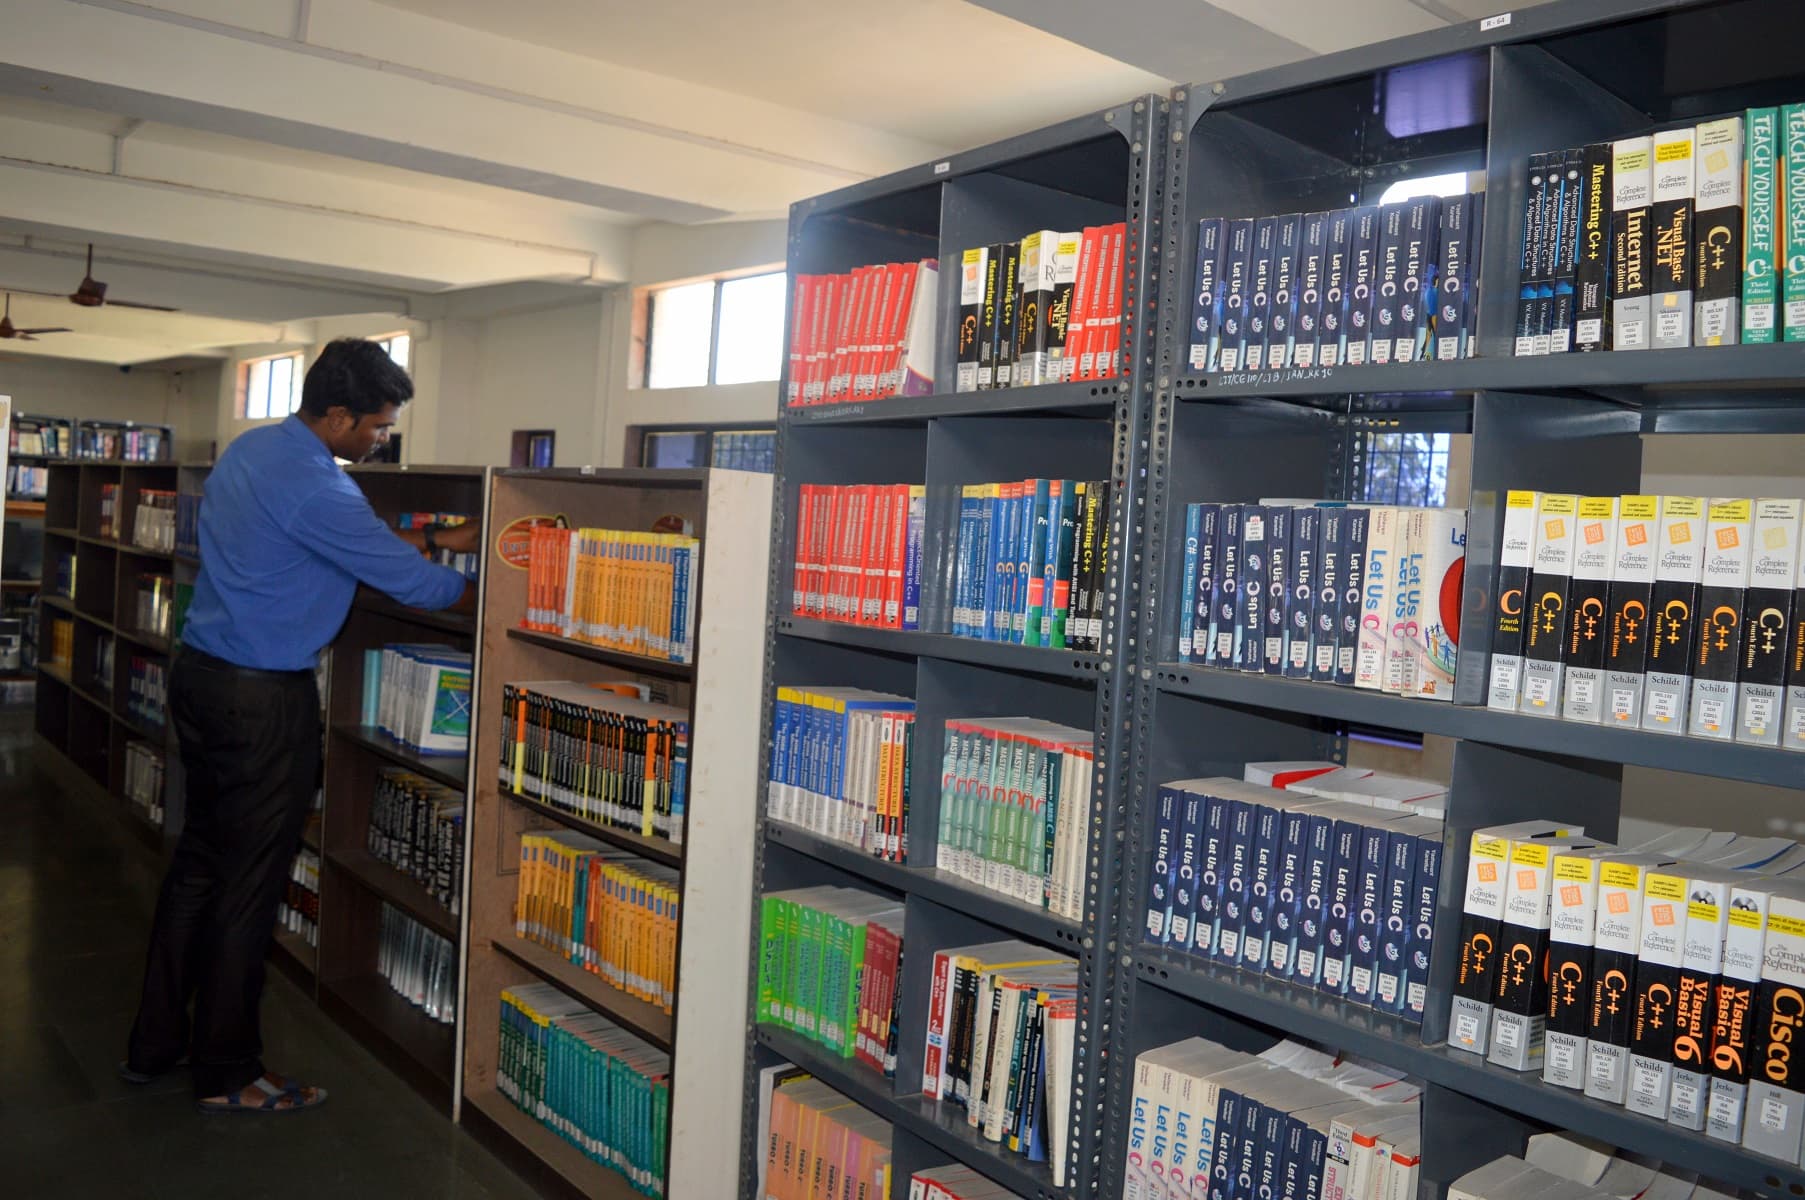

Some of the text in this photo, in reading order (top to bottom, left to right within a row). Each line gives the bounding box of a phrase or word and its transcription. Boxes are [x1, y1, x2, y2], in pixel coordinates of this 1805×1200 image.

[1753, 115, 1770, 251] TEACH YOURSELF
[1791, 112, 1805, 245] TEACH YOURSELF
[1587, 164, 1604, 259] Mastering C++
[1616, 233, 1625, 293] Second Edition
[1628, 209, 1646, 291] Internet
[1657, 226, 1672, 266] .NET
[1672, 207, 1685, 281] Visual Basic
[1708, 226, 1731, 269] C++
[1202, 278, 1212, 291] Us
[1203, 260, 1213, 275] Let
[1404, 241, 1421, 293] Let Us C
[1444, 241, 1460, 293] Let Us C
[985, 260, 996, 327] Mastering C++
[1004, 258, 1015, 325] Mastering C++
[1199, 292, 1211, 306] C
[1052, 300, 1062, 328] .NET
[1083, 498, 1097, 573] Mastering C++
[1187, 537, 1198, 554] C#
[1541, 547, 1565, 556] Complete
[1296, 551, 1310, 600] Let Us C
[1538, 554, 1565, 562] Reference
[1661, 560, 1691, 570] Reference
[1665, 553, 1692, 562] Complete
[1755, 565, 1787, 575] Reference
[1759, 558, 1788, 567] Complete
[1363, 550, 1386, 631] Let Us C
[1405, 554, 1423, 638] Let Us C
[1501, 590, 1522, 614] C
[1500, 624, 1519, 632] Edition
[1541, 592, 1562, 634] C++
[1582, 597, 1603, 640] C++
[1623, 600, 1645, 644] C++
[1665, 600, 1688, 644] C++
[1712, 606, 1737, 651] C++
[1760, 608, 1784, 654] C++
[1572, 632, 1580, 653] Edition
[1612, 635, 1620, 657] Edition
[1653, 635, 1661, 658] Edition
[1529, 662, 1555, 672] Schildt
[1571, 671, 1596, 680] Schildt
[1611, 674, 1638, 684] Schildt
[1651, 675, 1680, 686] Schildt
[1700, 683, 1729, 694] Schildt
[1746, 687, 1776, 697] Schildt
[1155, 828, 1169, 874] Let Us C
[1360, 873, 1376, 924] Let Us C
[1417, 887, 1433, 940] Let Us C
[1470, 895, 1496, 906] Reference
[1473, 889, 1497, 899] Complete
[1472, 934, 1493, 974] C++
[1644, 941, 1674, 953] Reference
[1648, 933, 1676, 944] Complete
[1457, 1000, 1483, 1013] Schildt
[1648, 983, 1671, 1029] C++
[1676, 976, 1694, 1028] Basic
[1690, 981, 1708, 1038] Visual
[1717, 984, 1734, 1036] Basic
[1729, 990, 1750, 1048] Visual
[1674, 1036, 1702, 1064] 6
[1766, 988, 1804, 1081] Cisco
[1634, 1059, 1663, 1073] Schildt
[1714, 1046, 1742, 1074] 6
[1716, 1081, 1733, 1092] Jerke
[1129, 1097, 1148, 1166] Let Us C
[1151, 1105, 1170, 1176] Let Us C
[1195, 1117, 1215, 1189] Let Us C
[1215, 1132, 1230, 1180] Let Us C
